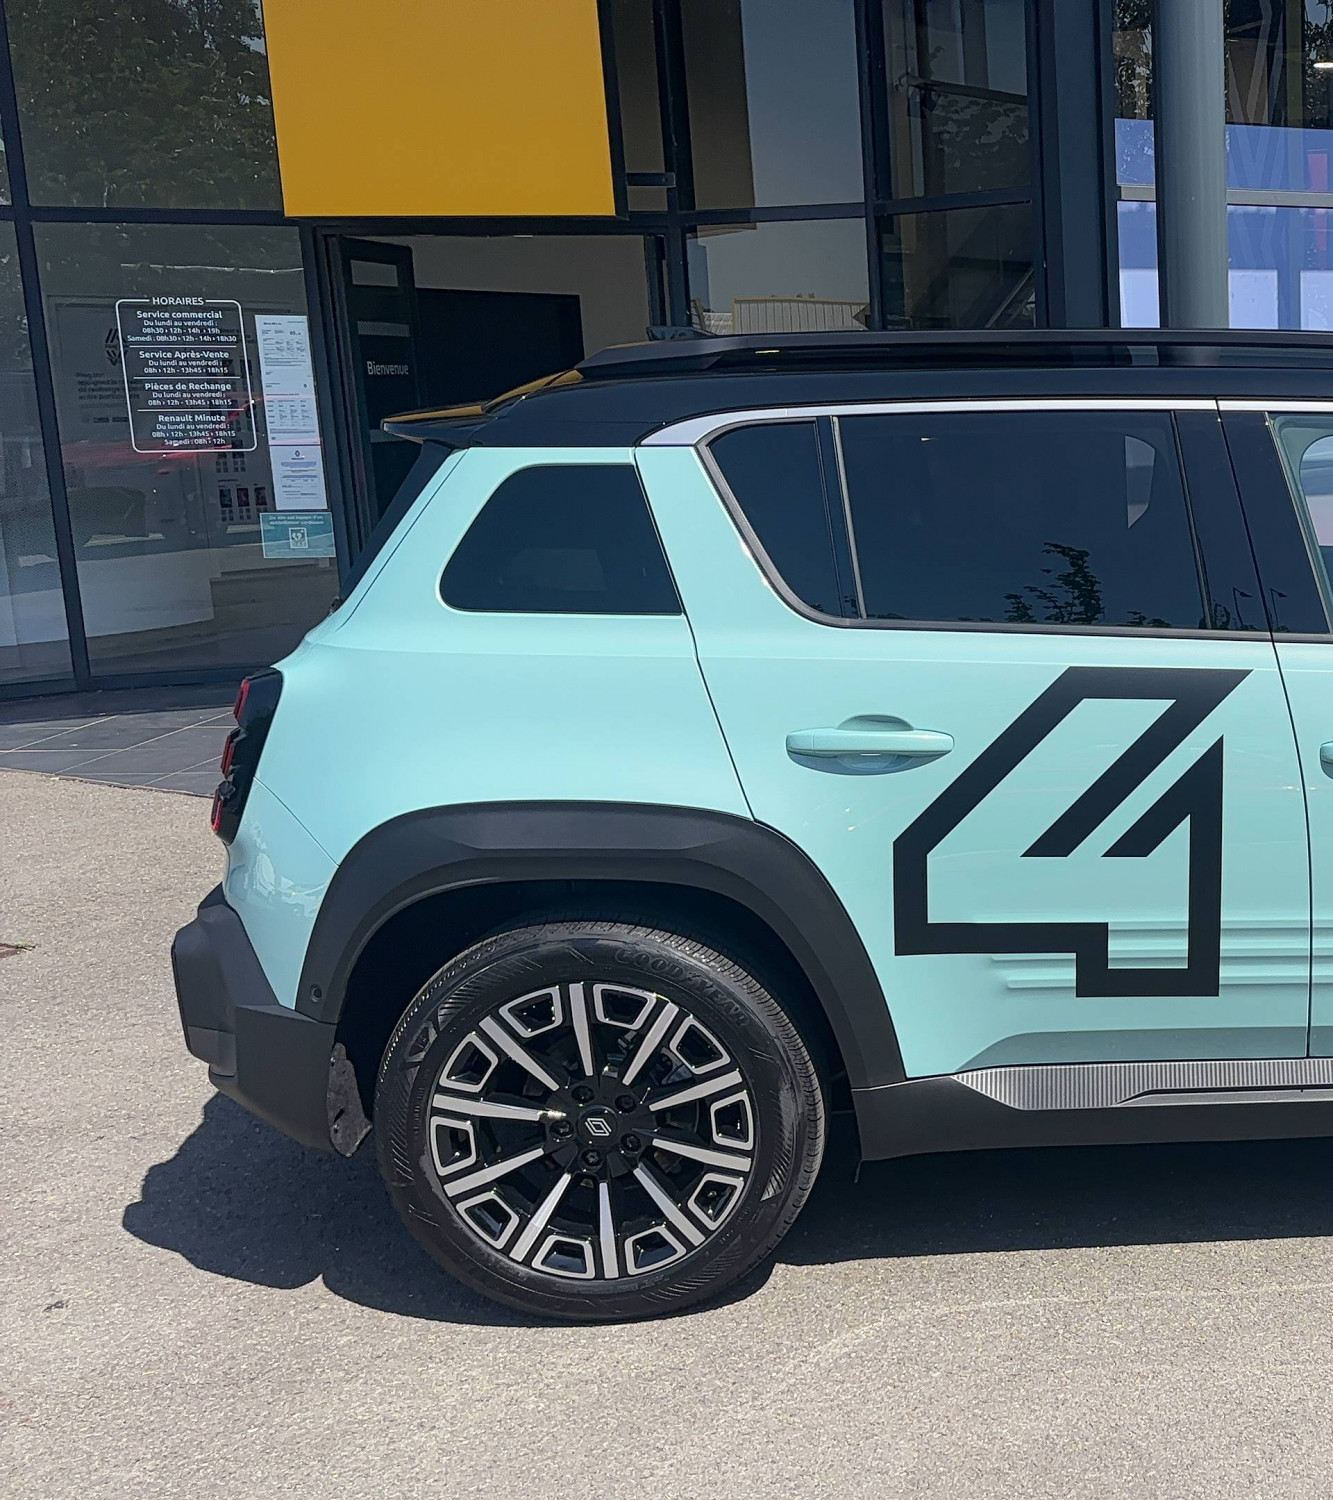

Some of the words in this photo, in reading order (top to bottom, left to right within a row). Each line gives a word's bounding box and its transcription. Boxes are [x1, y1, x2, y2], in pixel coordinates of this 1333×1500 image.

[152, 297, 204, 305] HORAIRES
[174, 351, 229, 359] Après-Vente
[366, 360, 409, 376] Bienvenue
[189, 383, 231, 391] Rechange
[158, 414, 193, 422] Renault
[195, 414, 226, 422] Minute
